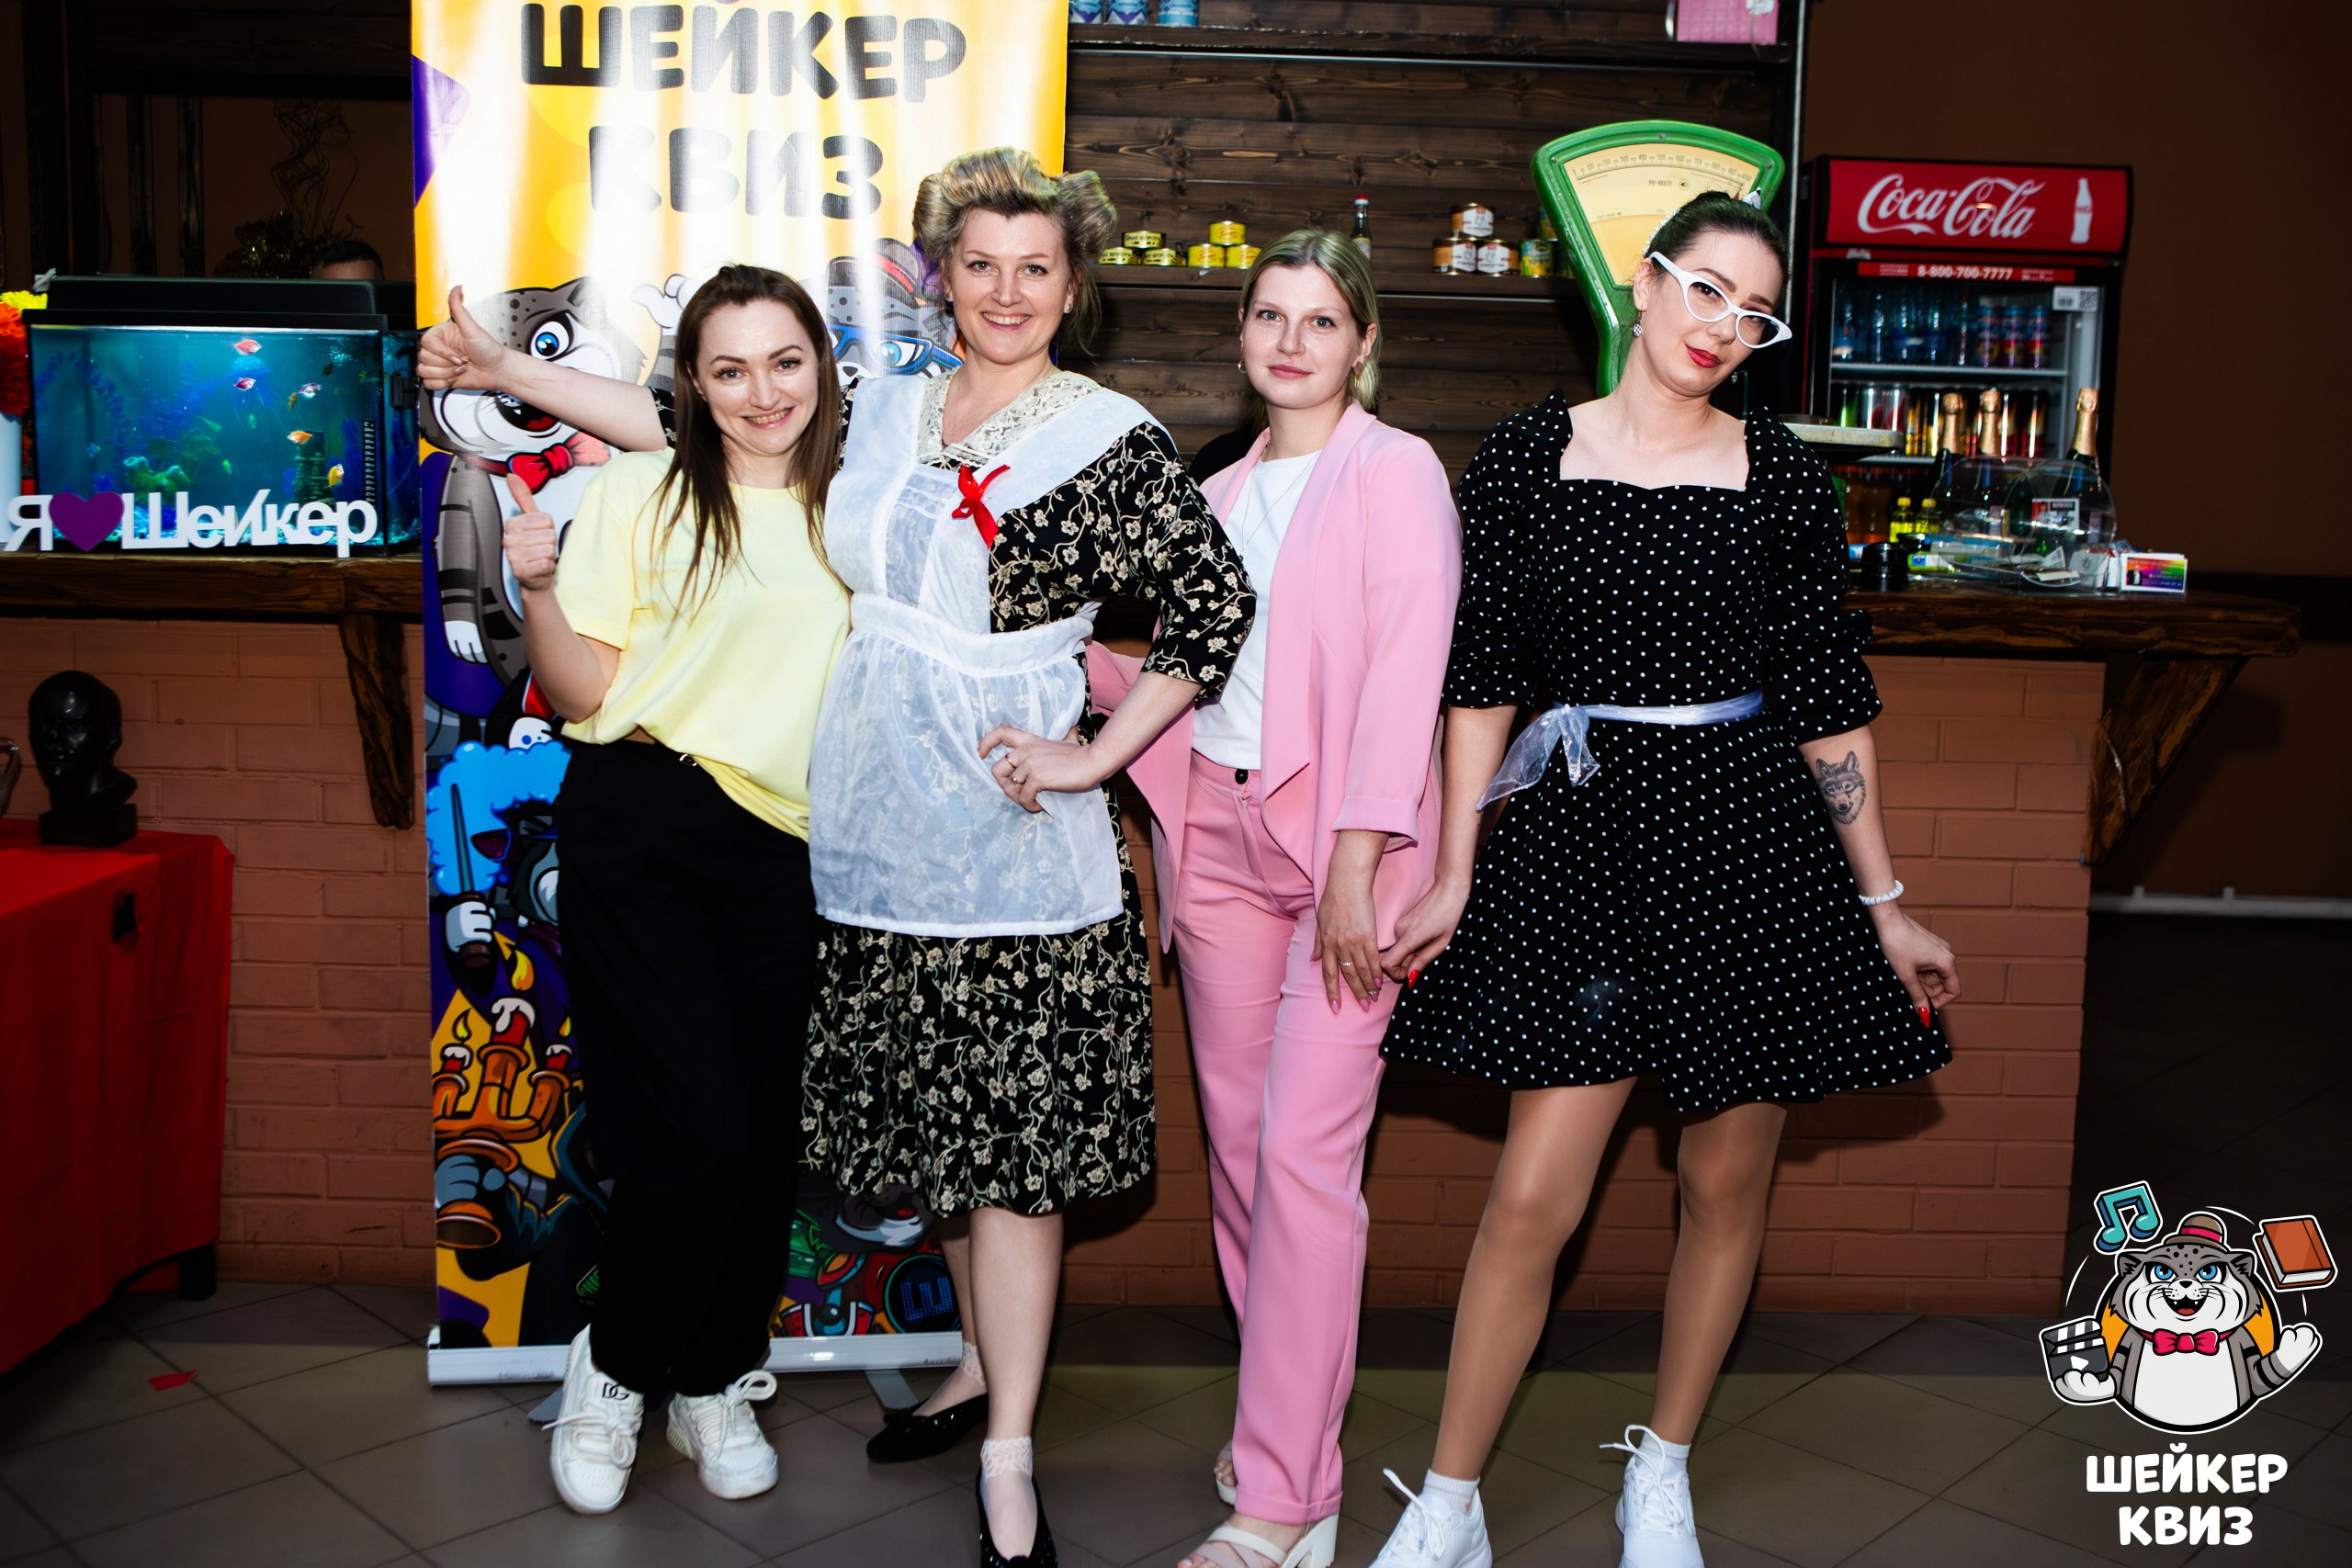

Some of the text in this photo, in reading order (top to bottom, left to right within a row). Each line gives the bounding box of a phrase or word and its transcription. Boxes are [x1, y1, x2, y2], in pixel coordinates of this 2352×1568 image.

[520, 0, 967, 103] ШЕЙКЕР
[588, 125, 884, 220] КВИЗ
[1917, 264, 2014, 281] 8-800-700-7777
[4, 489, 379, 558] Я Шейкер
